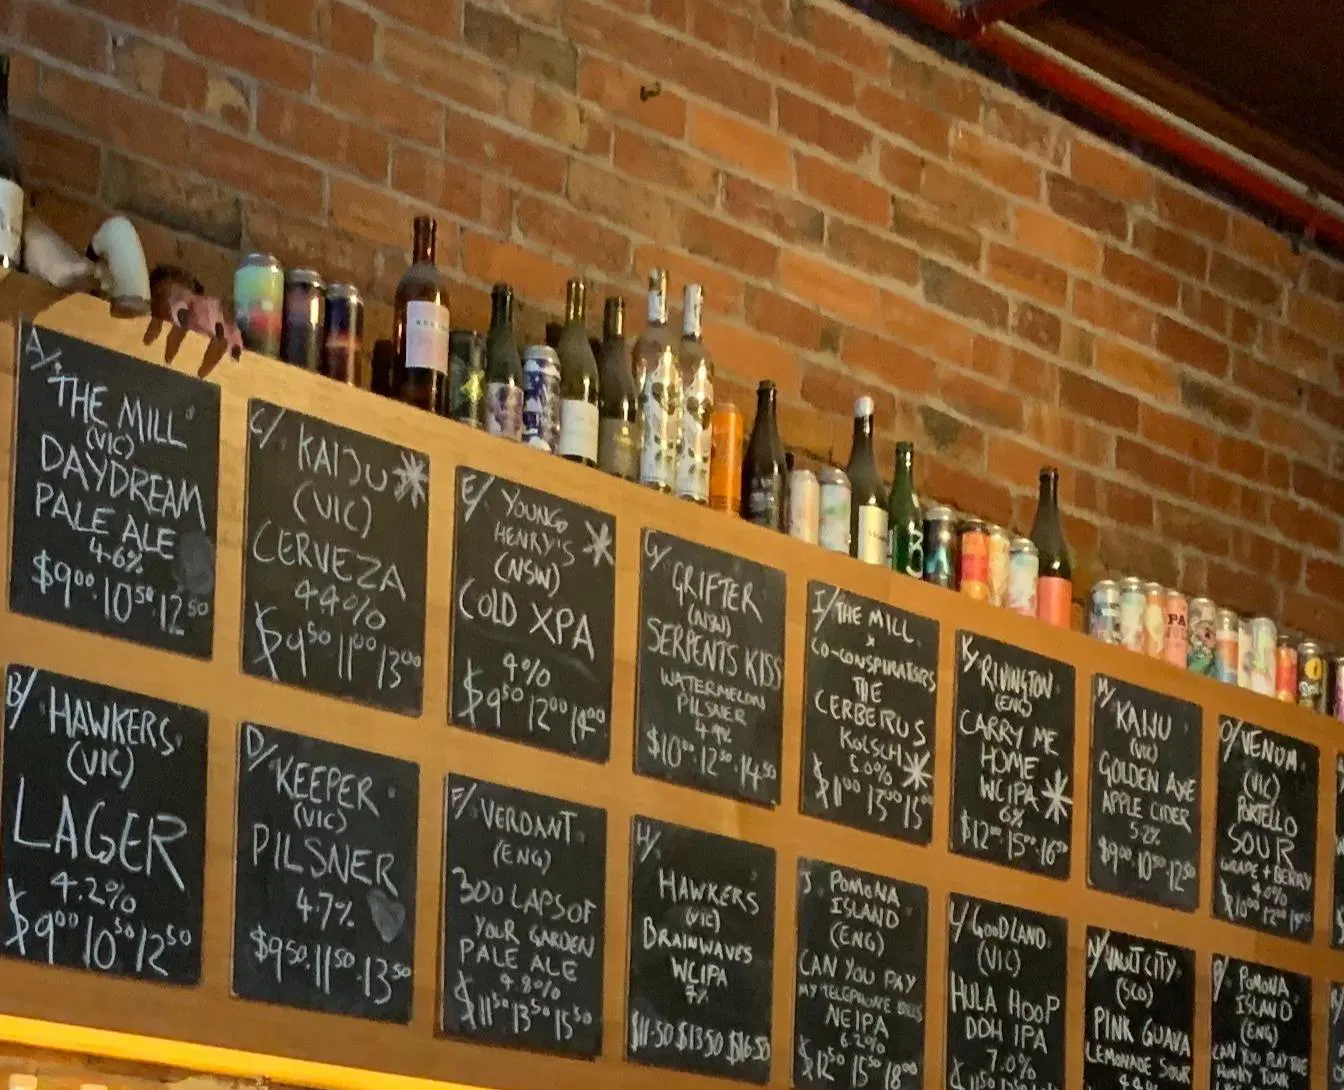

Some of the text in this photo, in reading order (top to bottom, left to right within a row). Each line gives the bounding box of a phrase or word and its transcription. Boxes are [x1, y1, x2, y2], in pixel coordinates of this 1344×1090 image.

[48, 377, 187, 449] THE MILL
[86, 427, 134, 459] (VIC)
[299, 423, 388, 491] KAIJU
[41, 435, 206, 531] DAYDREAM
[35, 482, 175, 559] PALE ALE
[294, 482, 371, 538] (VIC)
[253, 521, 406, 601] CERVEZA
[494, 520, 575, 567] HENRY'S
[494, 552, 560, 597] (NSW)
[673, 562, 763, 624] GRIFTER
[459, 577, 595, 662] COLD XPA
[836, 601, 915, 643] THE MILL
[647, 617, 782, 690] SERPENTS KISS
[660, 666, 766, 711] WATERMELON
[852, 676, 883, 703] THE
[981, 654, 1054, 699] RIVINGTON
[48, 685, 176, 756] HAWKERS
[677, 694, 747, 725] PILSNER
[815, 689, 927, 746] CERBERUS
[960, 710, 1058, 756] CARRY ME
[67, 741, 135, 790] (VIC)
[982, 743, 1039, 779] HOME
[1098, 751, 1196, 802] GOLDEN AXE
[274, 755, 380, 817] KEEPER
[293, 802, 347, 833] (VIC)
[480, 798, 578, 846] VERDANT
[1103, 791, 1192, 833] APPLE CIDER
[12, 777, 188, 894] LAGER
[493, 840, 552, 874] (ENG)
[1228, 825, 1294, 869] SOUR
[252, 823, 399, 897] PILSNER
[452, 867, 596, 924] 300 LAPS OF
[659, 868, 760, 917] HAWKERS
[830, 871, 901, 908] POMONA
[830, 897, 900, 929] ISLAND
[972, 905, 1048, 950] GOODLAND
[475, 915, 596, 958] YOUR GARDEN
[643, 915, 753, 963] BRAINWAVES
[829, 921, 885, 957] (ENG)
[459, 939, 579, 981] PALE ALE
[799, 949, 917, 993] CAN YOU PAY
[978, 945, 1021, 977] (VIC)
[1145, 950, 1177, 983] CITY
[950, 972, 1060, 1025] HULA HOOP
[1235, 994, 1293, 1022] ISLAND
[1014, 1024, 1048, 1054] IPA
[1094, 1006, 1191, 1058] PINK GUAVA
[1086, 1041, 1191, 1084] LEMONADE SOUR
